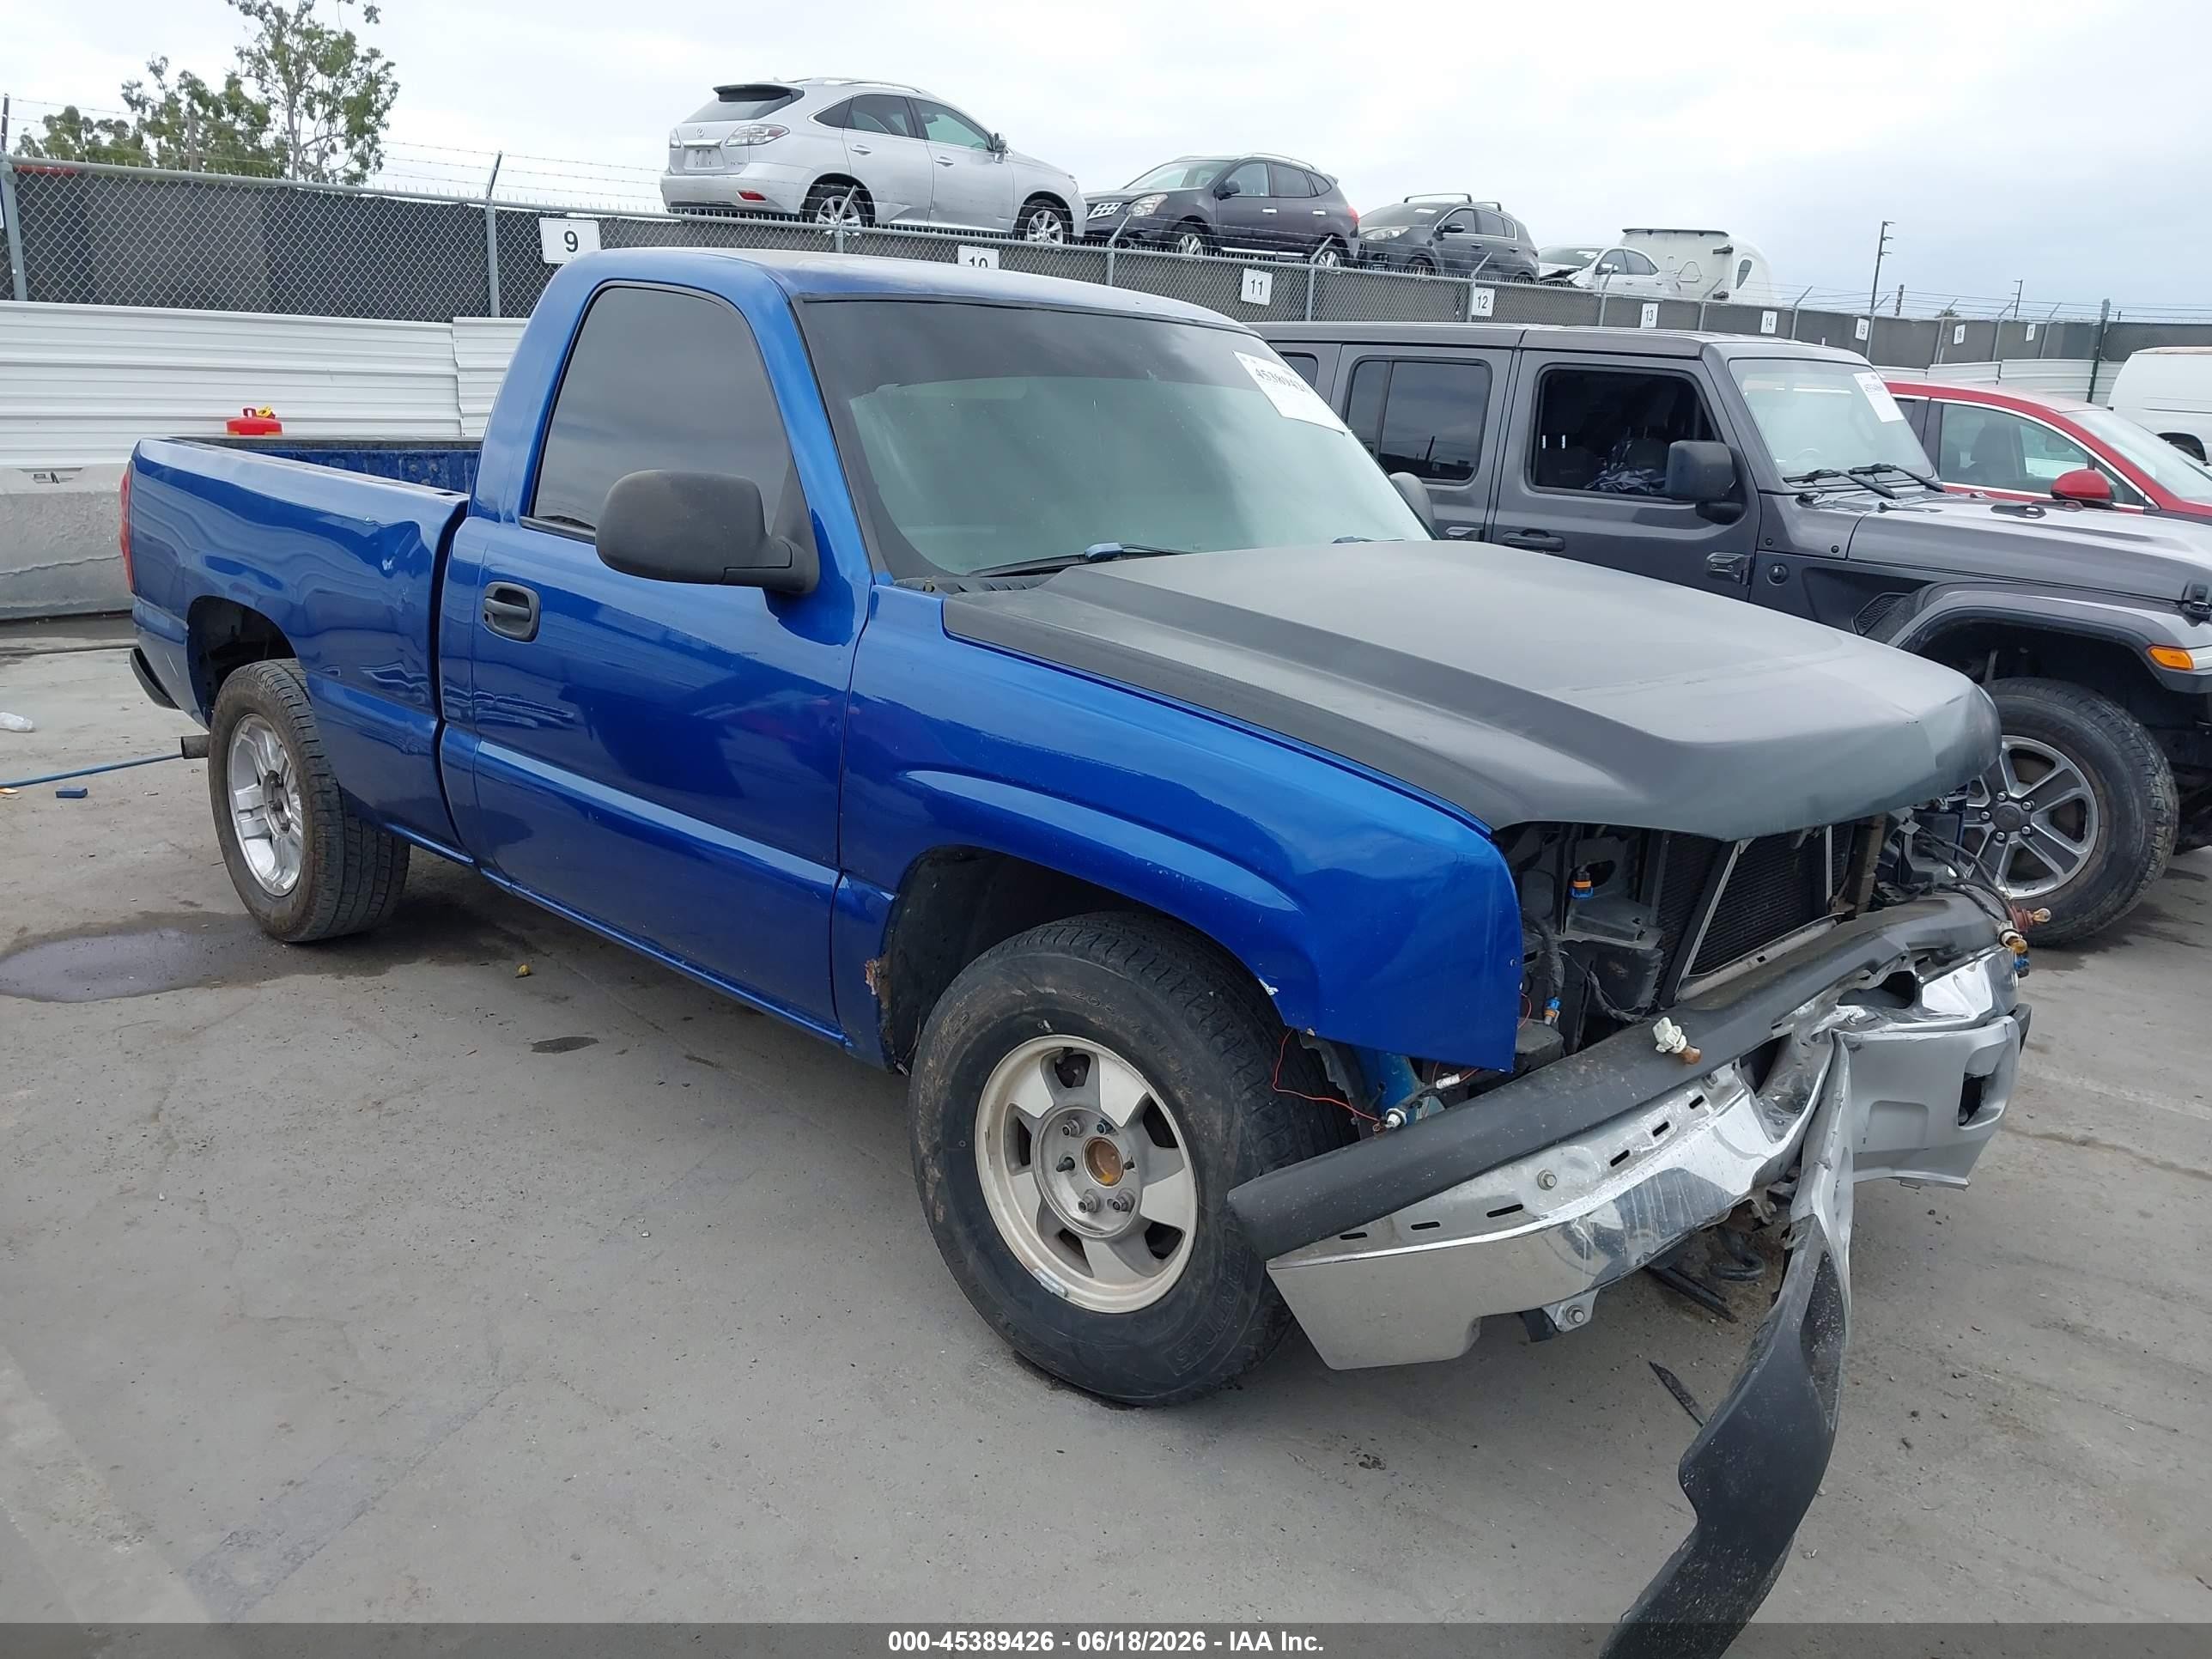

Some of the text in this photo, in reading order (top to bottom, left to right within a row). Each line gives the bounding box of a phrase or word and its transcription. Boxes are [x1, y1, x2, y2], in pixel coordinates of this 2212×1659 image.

[563, 230, 579, 253] 9
[968, 256, 988, 268] 10
[1250, 278, 1264, 296] 11
[1476, 295, 1489, 309] 12
[1645, 309, 1654, 323] 13
[1765, 317, 1773, 328] 14
